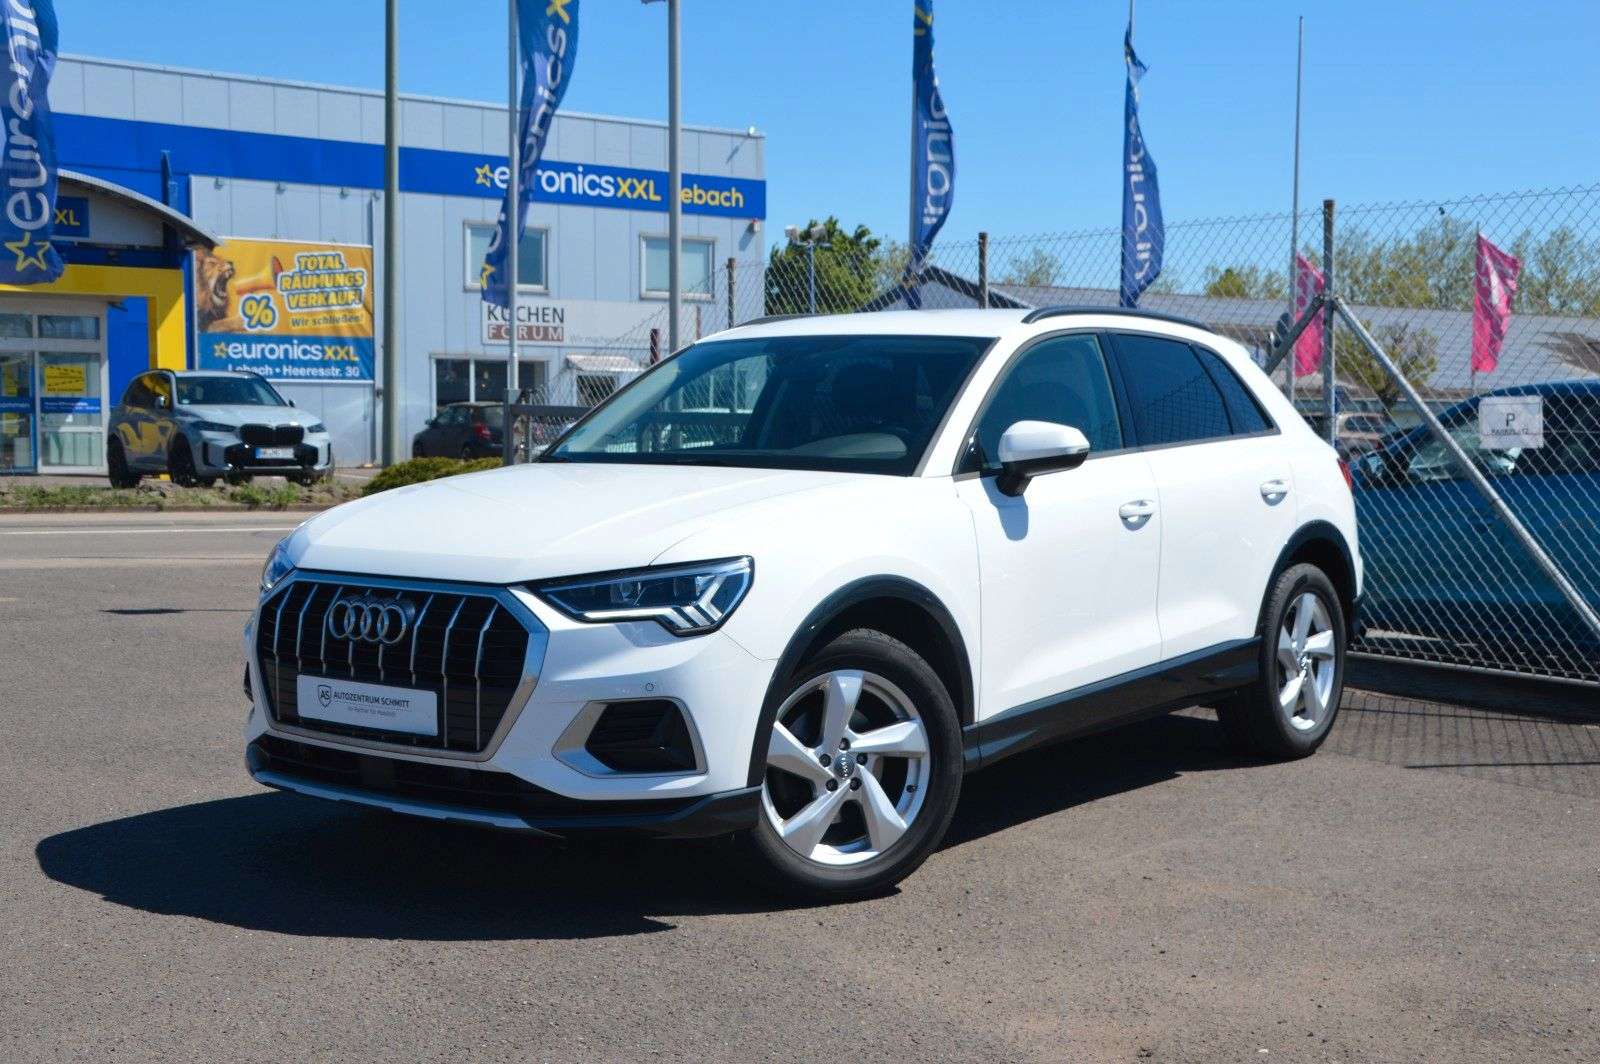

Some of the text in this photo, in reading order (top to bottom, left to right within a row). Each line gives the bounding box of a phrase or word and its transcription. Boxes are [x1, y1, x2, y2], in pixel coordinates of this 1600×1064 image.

[494, 163, 744, 208] eonics XXL ebach
[54, 208, 81, 226] XL
[299, 254, 343, 270] TOTAL
[228, 339, 322, 360] euronics
[345, 366, 360, 377] 30
[1506, 412, 1516, 427] P
[333, 691, 380, 704] AUTOZENTRUM
[381, 696, 411, 709] SCHMITT
